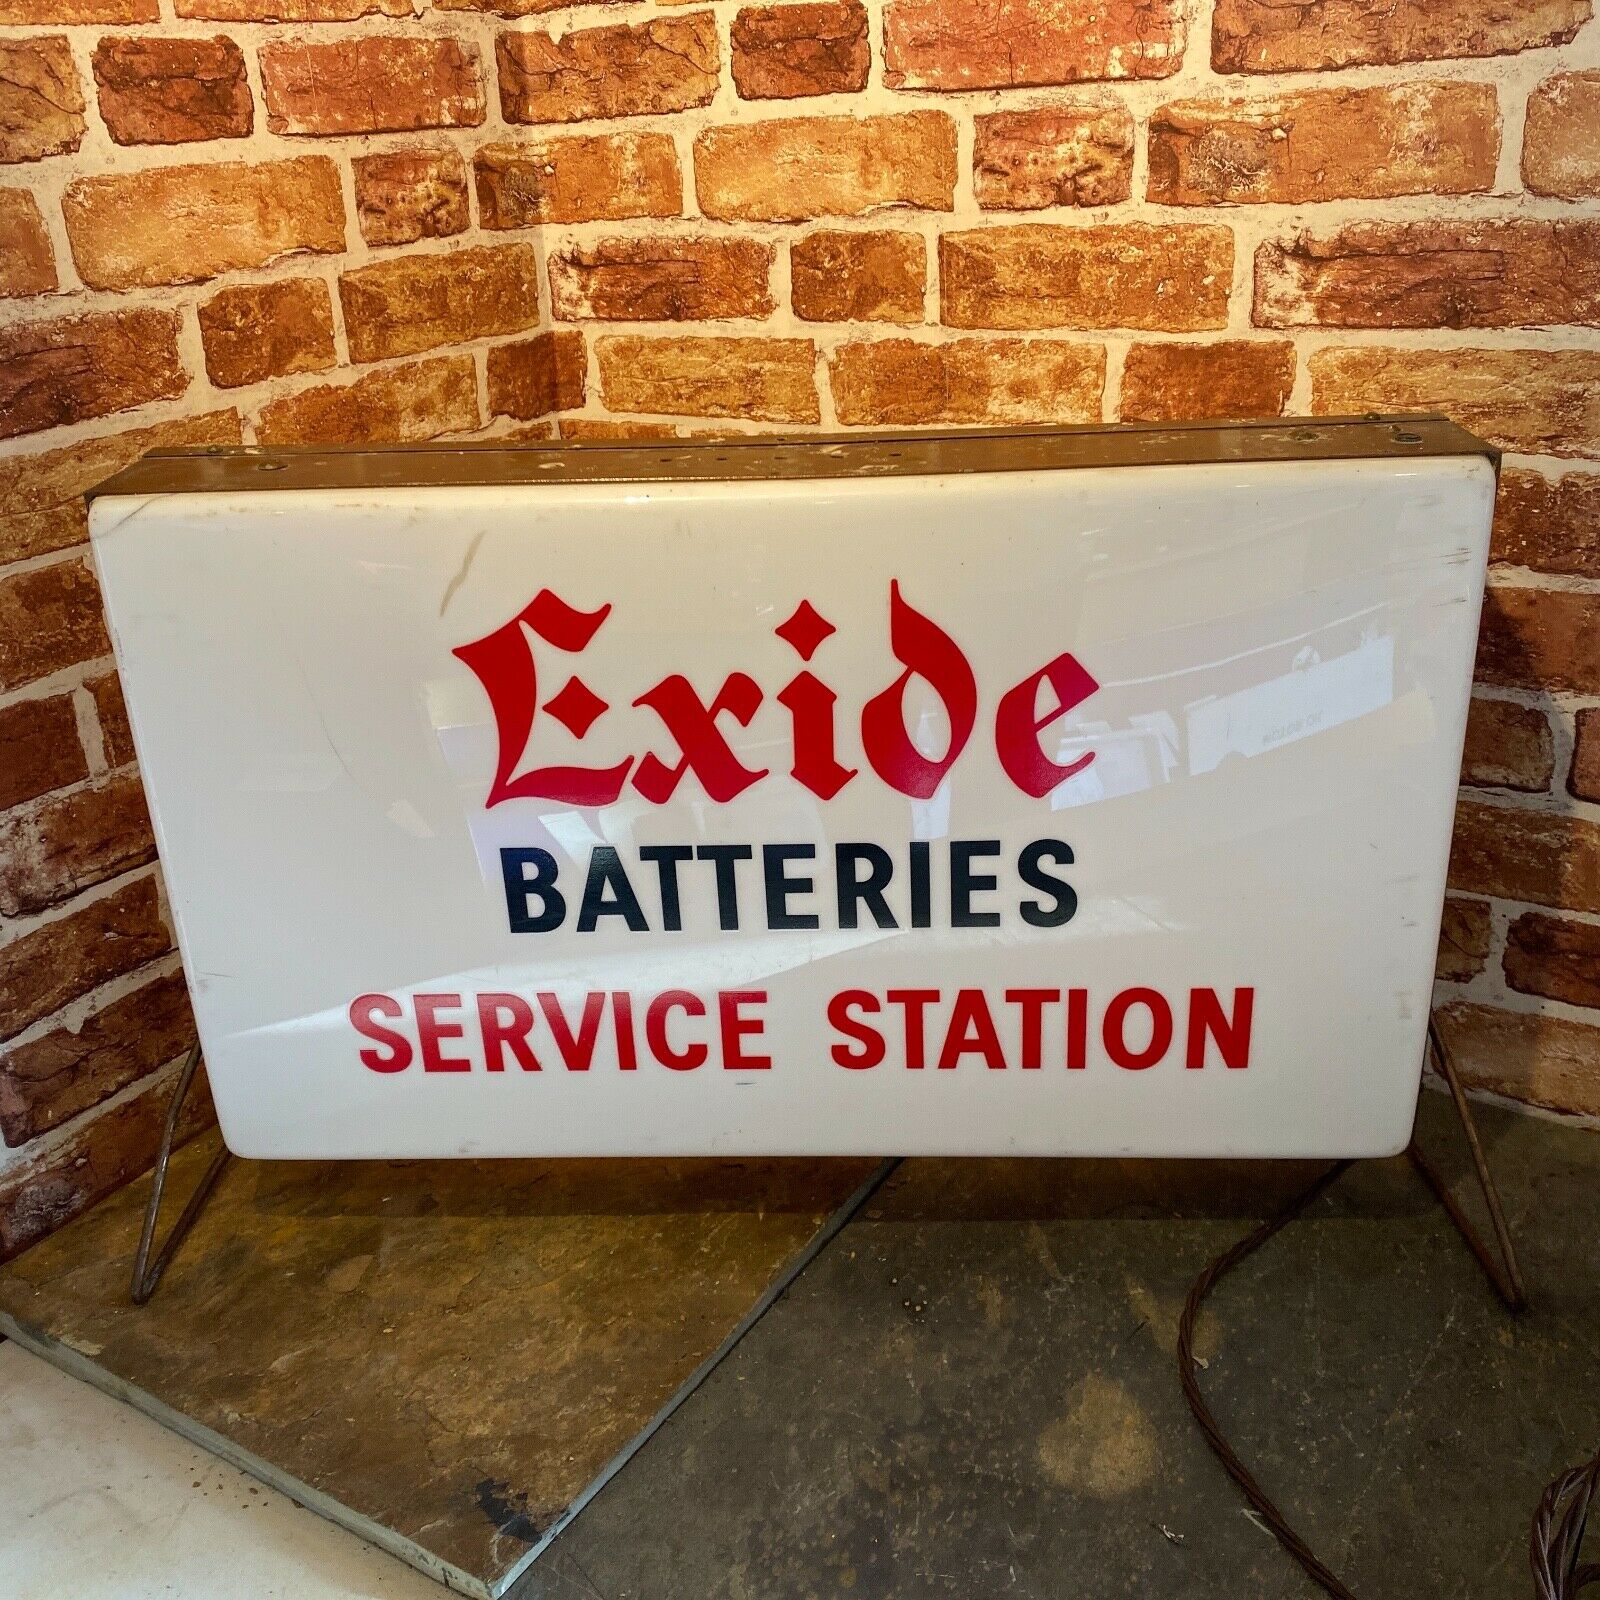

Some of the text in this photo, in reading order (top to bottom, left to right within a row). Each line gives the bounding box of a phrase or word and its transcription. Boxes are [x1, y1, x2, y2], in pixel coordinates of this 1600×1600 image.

[452, 579, 1100, 809] Exide
[500, 838, 1078, 934] BATTERIES
[348, 986, 1253, 1074] SERVICE STATION
